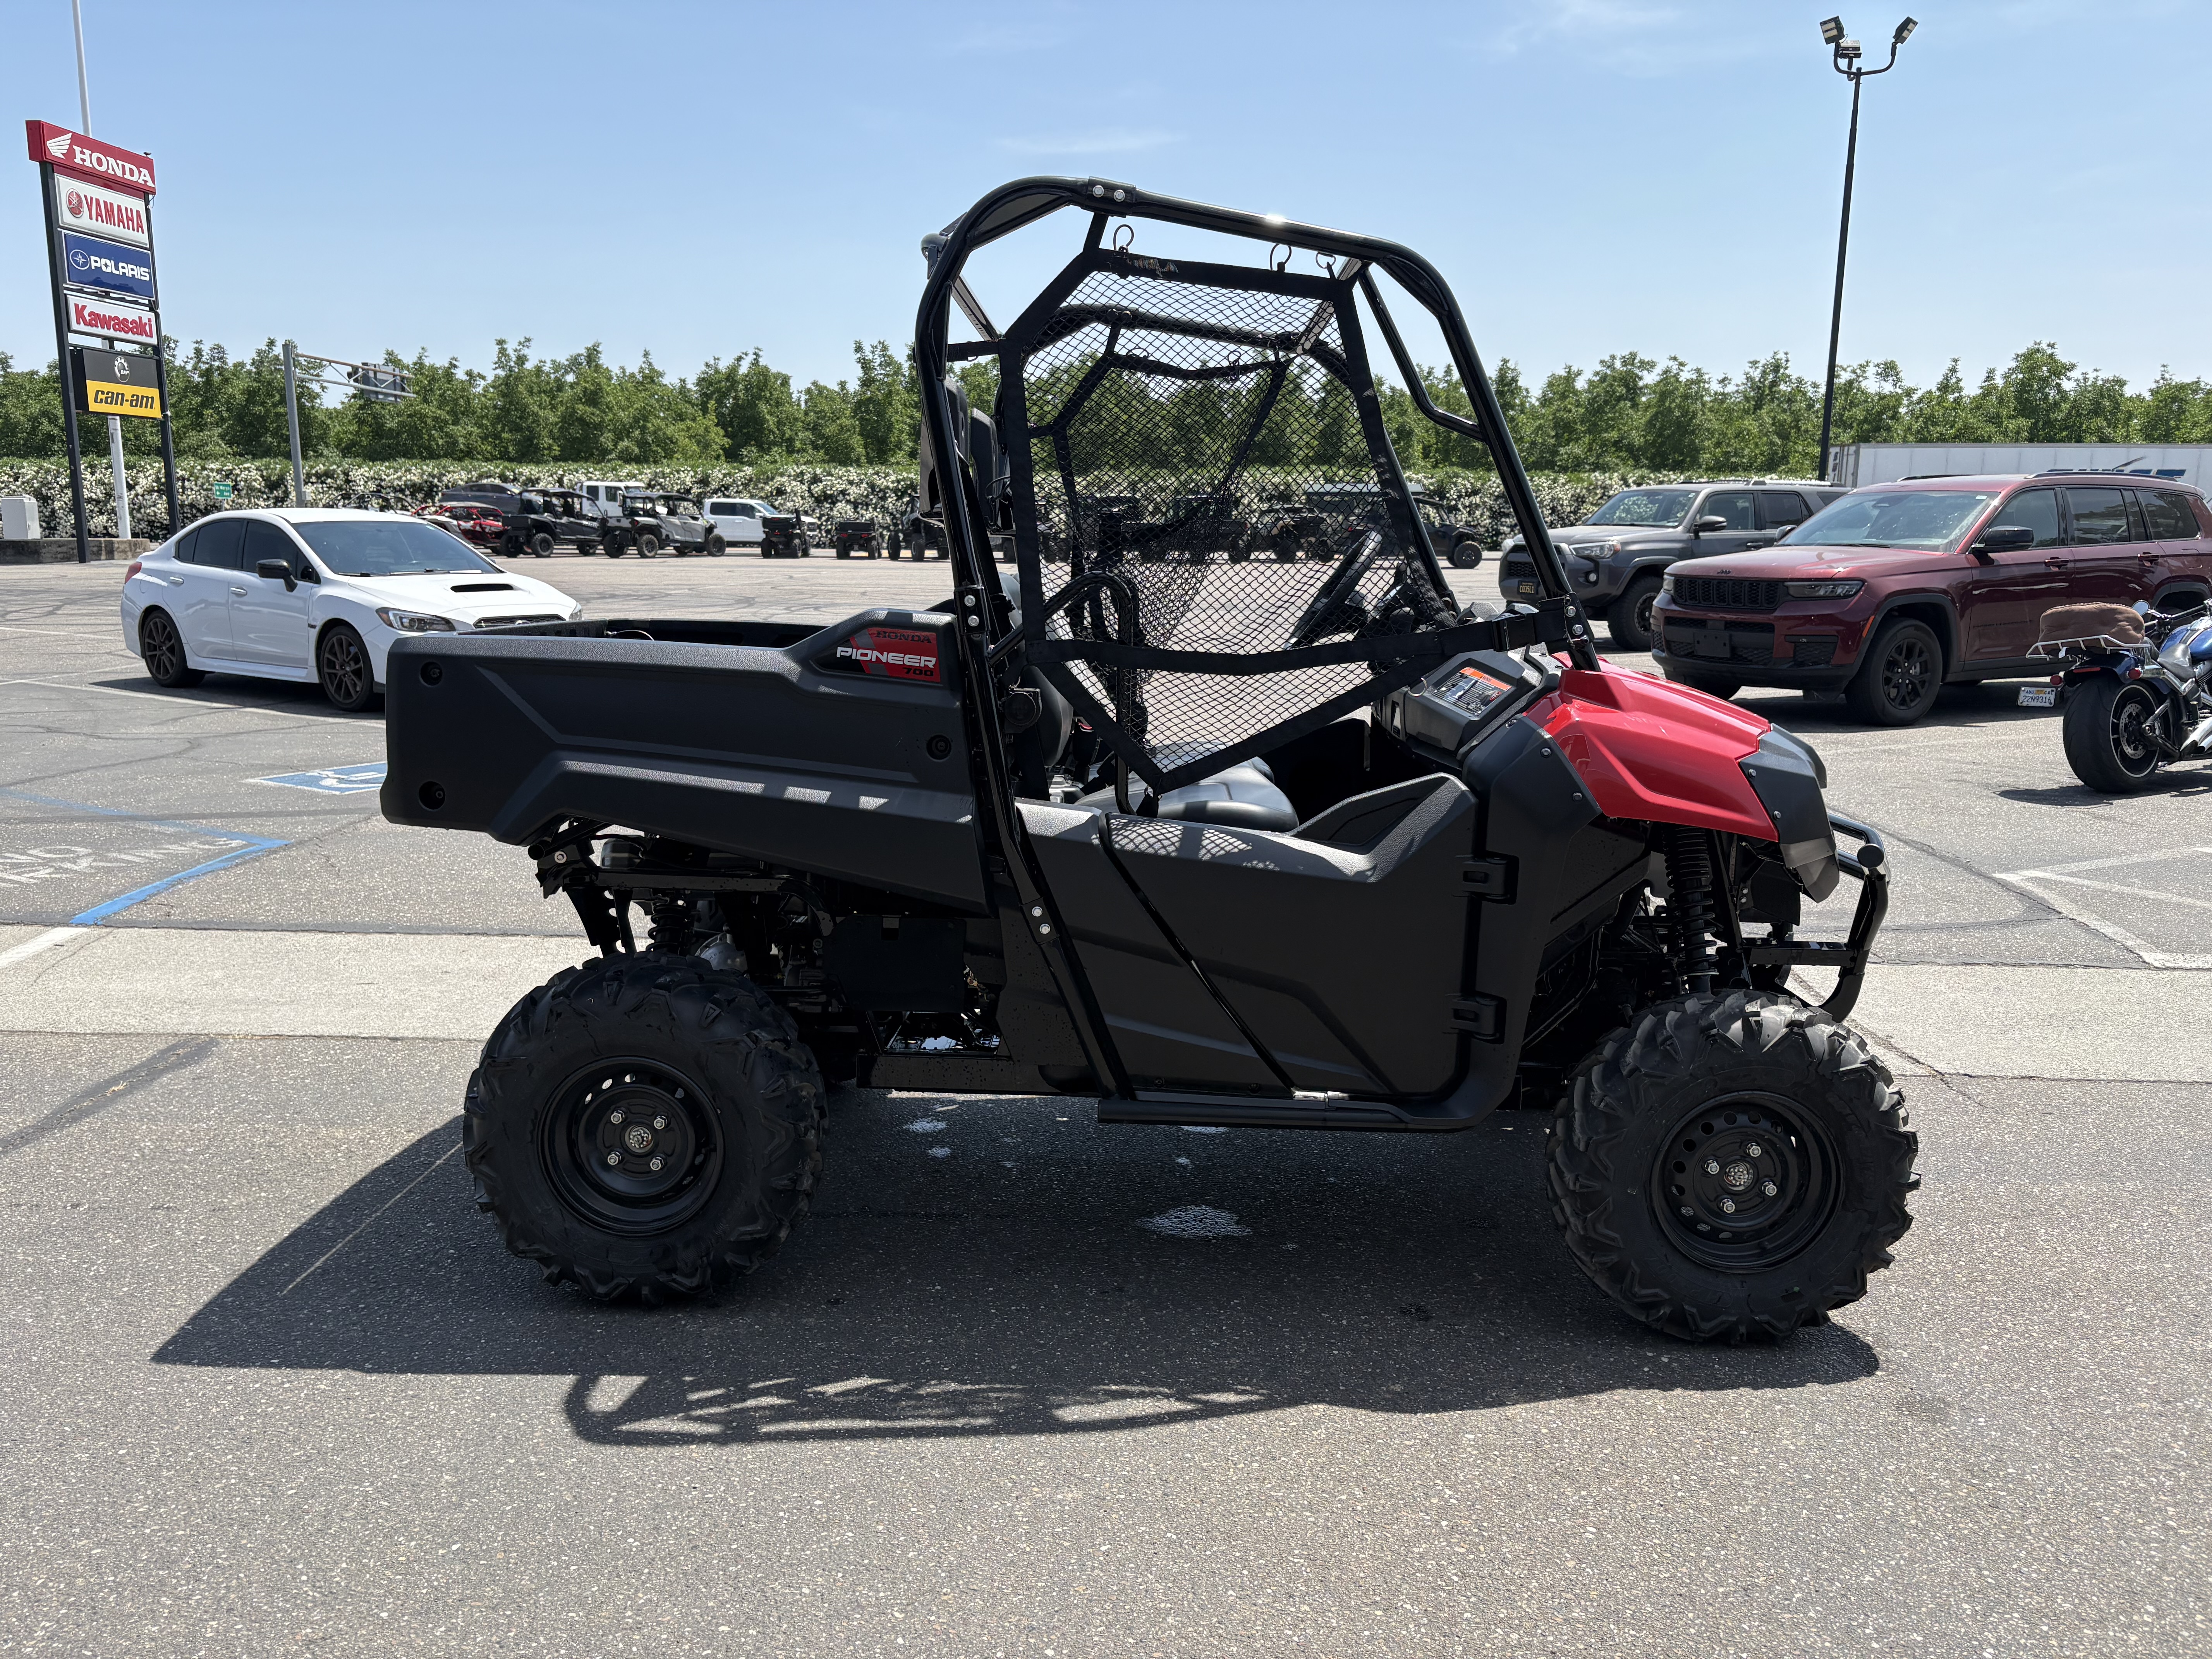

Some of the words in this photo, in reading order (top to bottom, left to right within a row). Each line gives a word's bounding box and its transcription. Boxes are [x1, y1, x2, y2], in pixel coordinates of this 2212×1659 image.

[72, 145, 155, 187] HONDA
[84, 194, 144, 234] YAMAHA
[90, 256, 149, 281] POLARIS
[74, 303, 153, 338] Kawasaki
[94, 390, 155, 409] can-am
[875, 630, 932, 644] HONDA
[836, 647, 936, 668] PIONEER
[902, 667, 934, 677] 700
